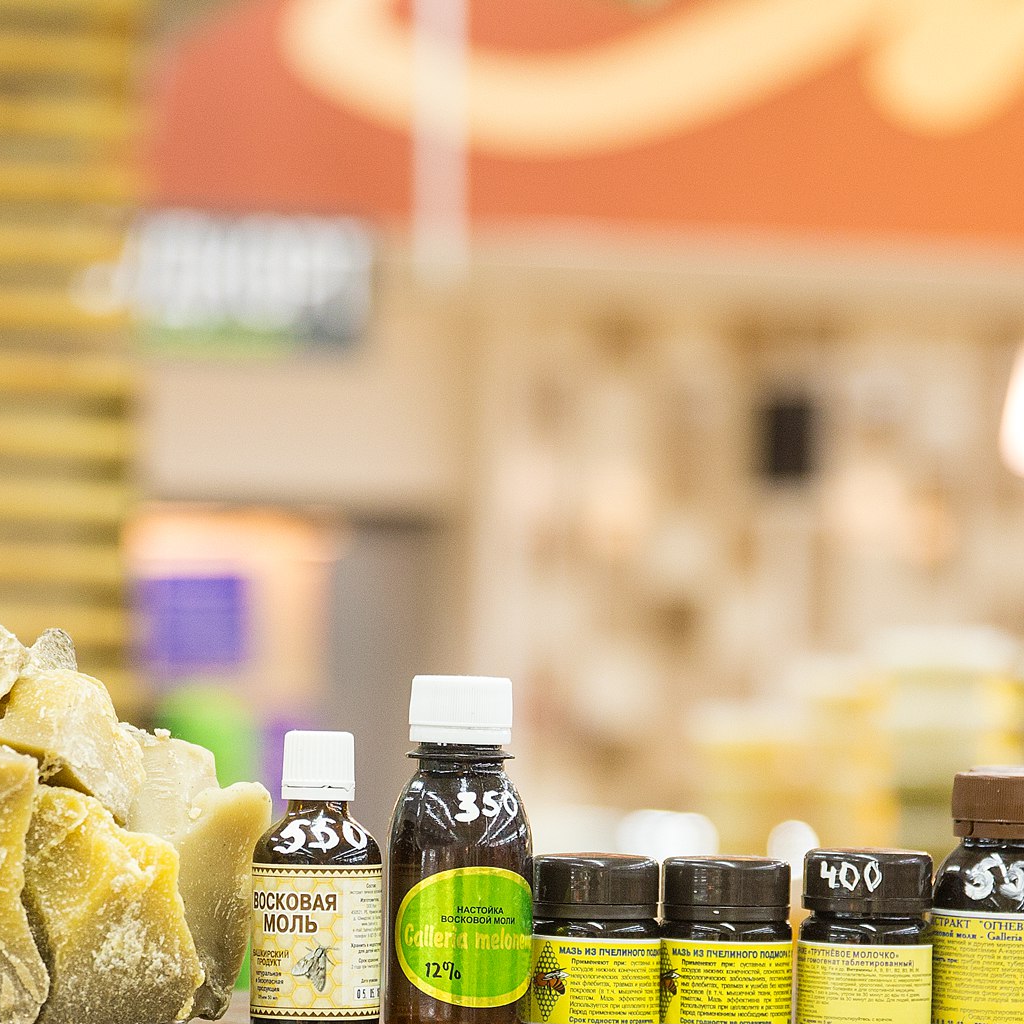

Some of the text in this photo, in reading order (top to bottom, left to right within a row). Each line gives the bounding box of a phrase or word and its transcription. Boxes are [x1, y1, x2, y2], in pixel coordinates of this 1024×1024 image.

[820, 860, 883, 893] 400
[253, 890, 338, 912] ВОСКОВАЯ
[457, 905, 504, 915] НАСТОЙКА
[263, 914, 318, 934] МОЛЬ
[441, 915, 516, 925] ВОСКОВОЙ МОЛИ
[956, 931, 1023, 942] моли Galleria
[559, 946, 645, 957] МАЗЬ ИЗ ПЧЕЛИНОГО
[672, 947, 758, 958] МАЗЬ ИЗ ПЧЕЛИНОГО
[257, 958, 282, 967] ПРОДУКТ
[571, 958, 609, 966] Применяют
[425, 961, 462, 981] 12%
[569, 1016, 586, 1024] Срок
